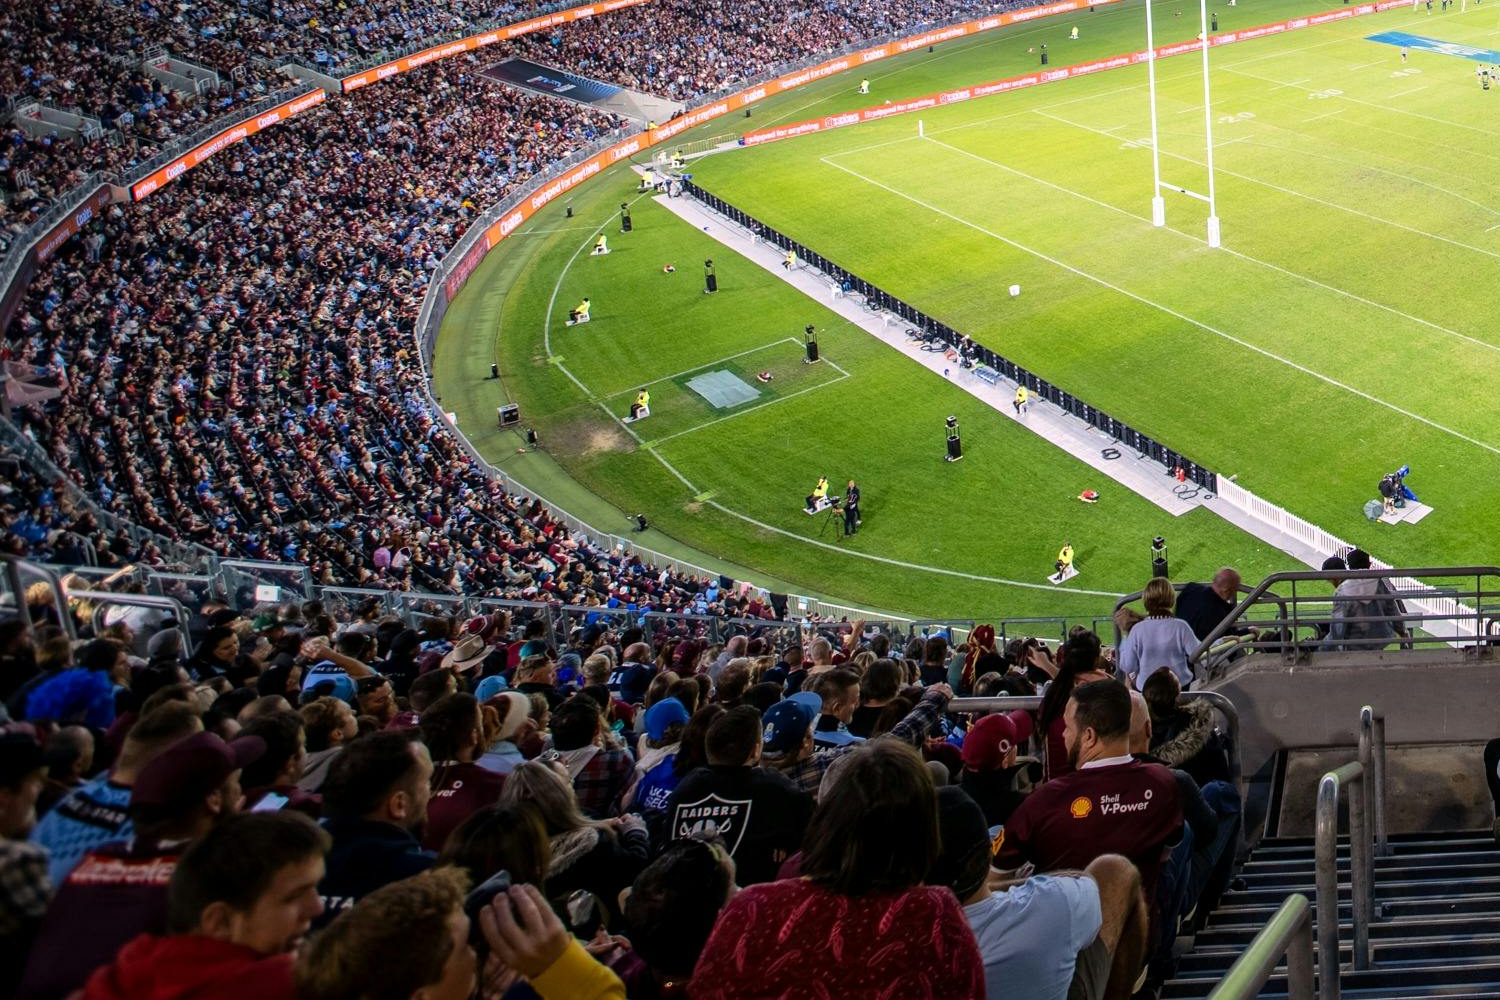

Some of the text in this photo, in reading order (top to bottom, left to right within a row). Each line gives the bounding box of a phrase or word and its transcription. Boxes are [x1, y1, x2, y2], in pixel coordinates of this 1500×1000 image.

[1217, 111, 1256, 124] 20
[166, 161, 187, 180] Coates
[500, 210, 524, 236] Coates
[1100, 793, 1120, 804] Shell
[681, 805, 739, 819] RAIDERS
[1100, 801, 1149, 815] V-Power
